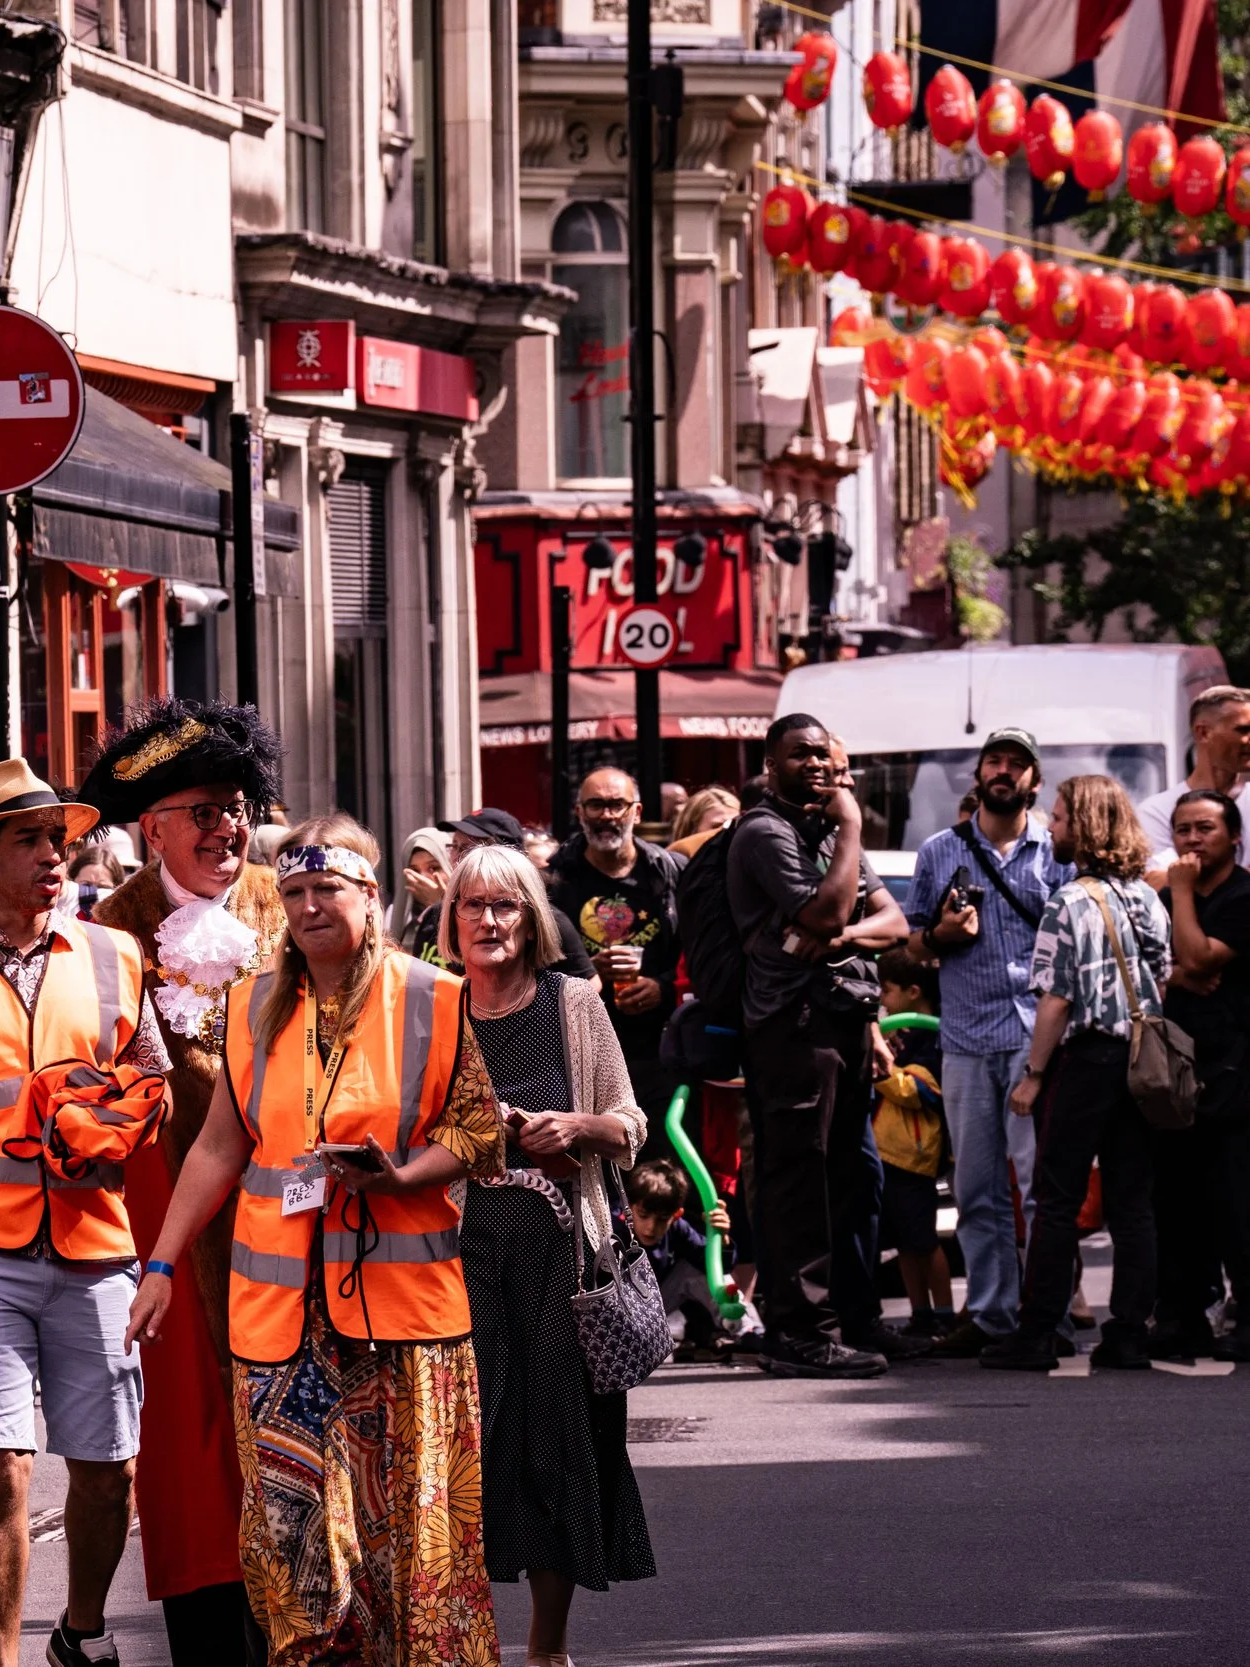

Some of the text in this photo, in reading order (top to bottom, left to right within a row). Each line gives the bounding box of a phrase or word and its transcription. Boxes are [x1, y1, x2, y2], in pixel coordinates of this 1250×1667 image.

[625, 623, 670, 649] 20
[480, 720, 599, 746] NEWS LOERY
[306, 1028, 314, 1056] PRESS
[325, 1052, 340, 1080] PRESS
[306, 1087, 314, 1117] PRESS
[286, 1181, 315, 1199] PRESS
[288, 1192, 312, 1206] BBC
